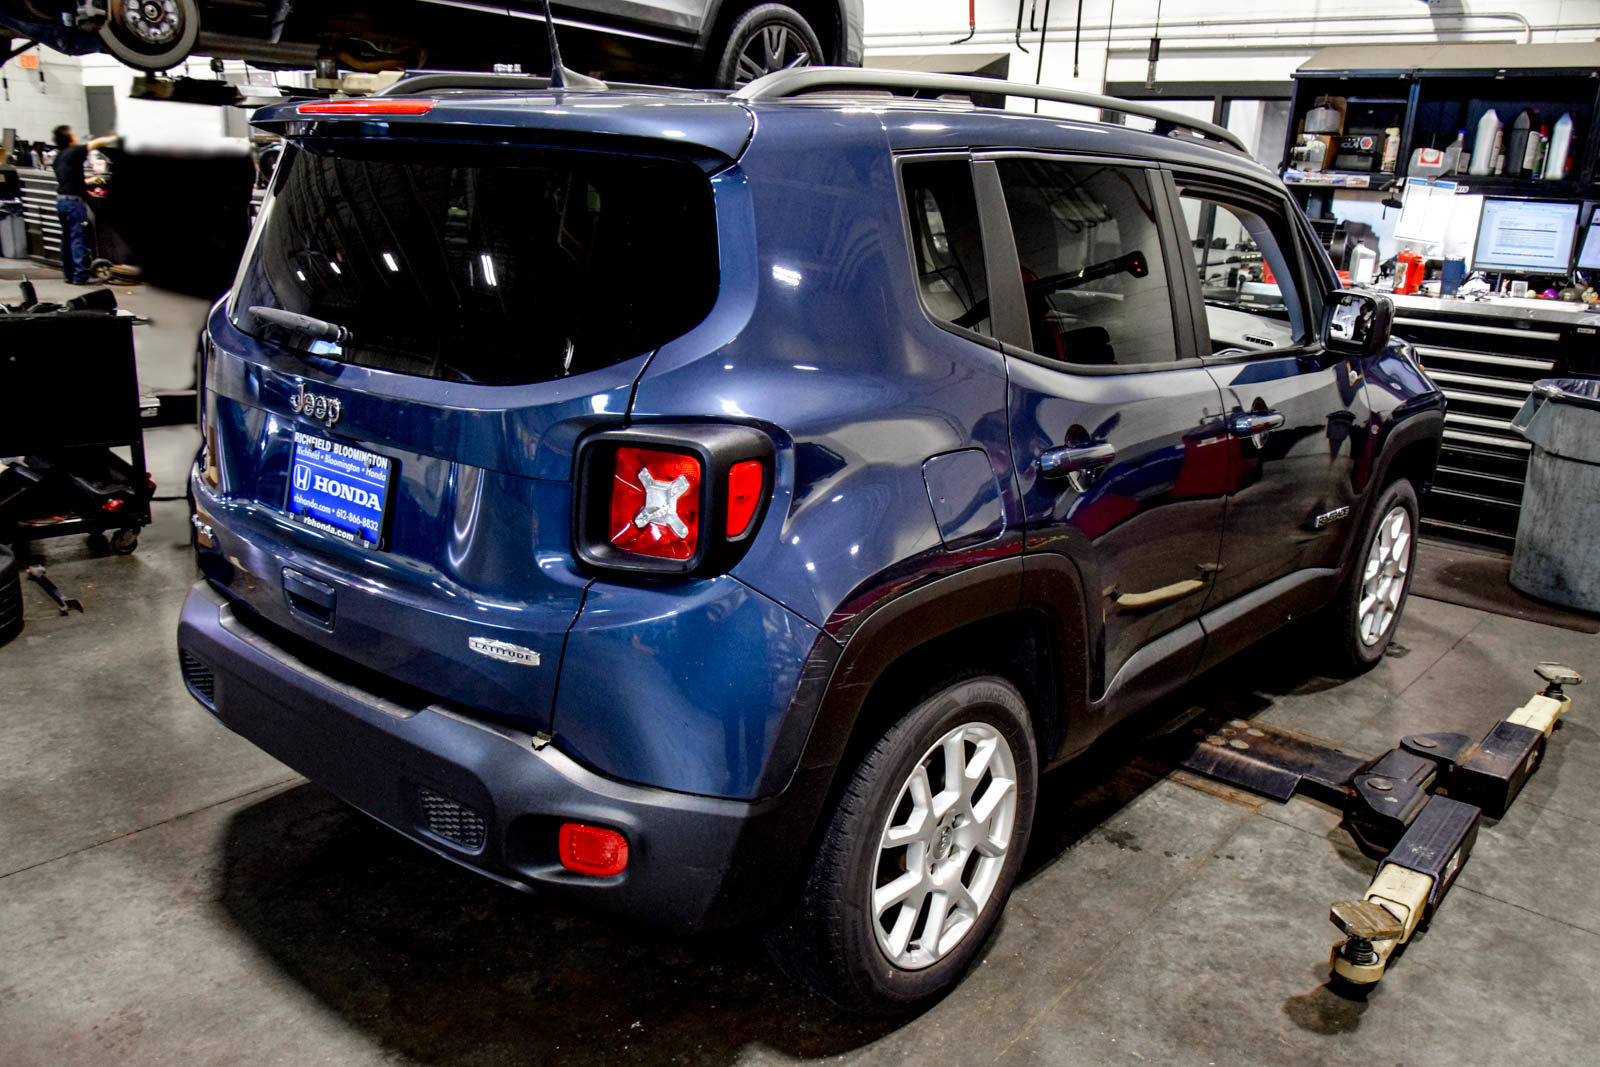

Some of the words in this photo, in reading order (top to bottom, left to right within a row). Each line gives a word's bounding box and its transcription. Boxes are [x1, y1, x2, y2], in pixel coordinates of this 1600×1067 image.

[290, 383, 341, 427] Jeep
[295, 431, 332, 452] RICHFIELD
[334, 443, 388, 470] BLOOMINGTON
[296, 446, 320, 461] Richfield
[324, 454, 361, 474] Bloomington
[365, 468, 386, 482] Honda
[314, 475, 382, 512] HONDA
[293, 493, 331, 515] rbhonda.com
[336, 507, 379, 532] 612-866-8832
[303, 517, 355, 541] rbhonda.com
[475, 642, 531, 660] LATITUDE
